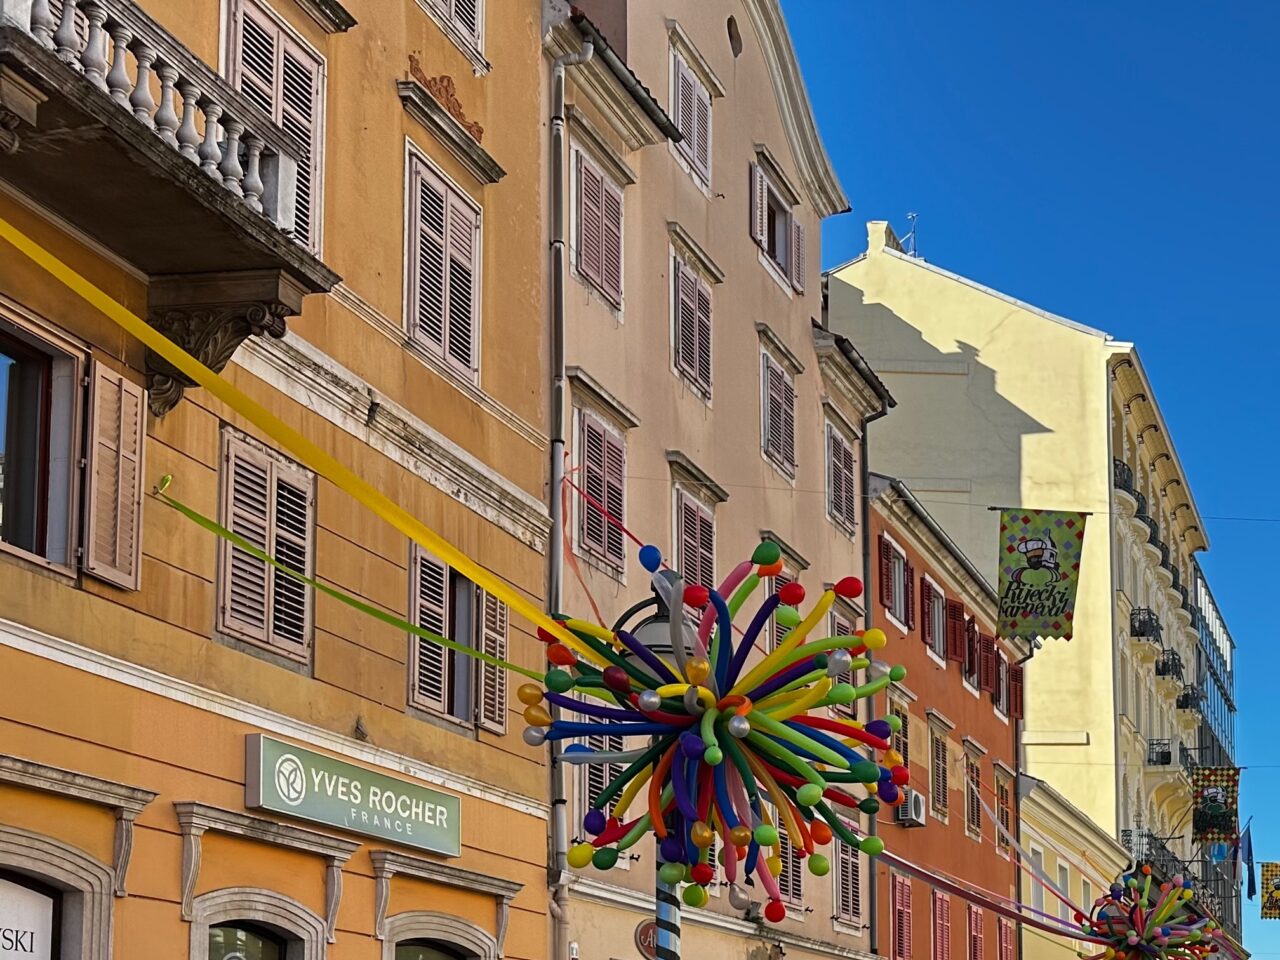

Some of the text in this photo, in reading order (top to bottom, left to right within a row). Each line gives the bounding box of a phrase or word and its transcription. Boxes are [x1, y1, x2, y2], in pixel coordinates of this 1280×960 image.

[311, 767, 448, 829] YVES ROCHER
[351, 808, 413, 835] FRANCE
[0, 928, 35, 953] SKI
